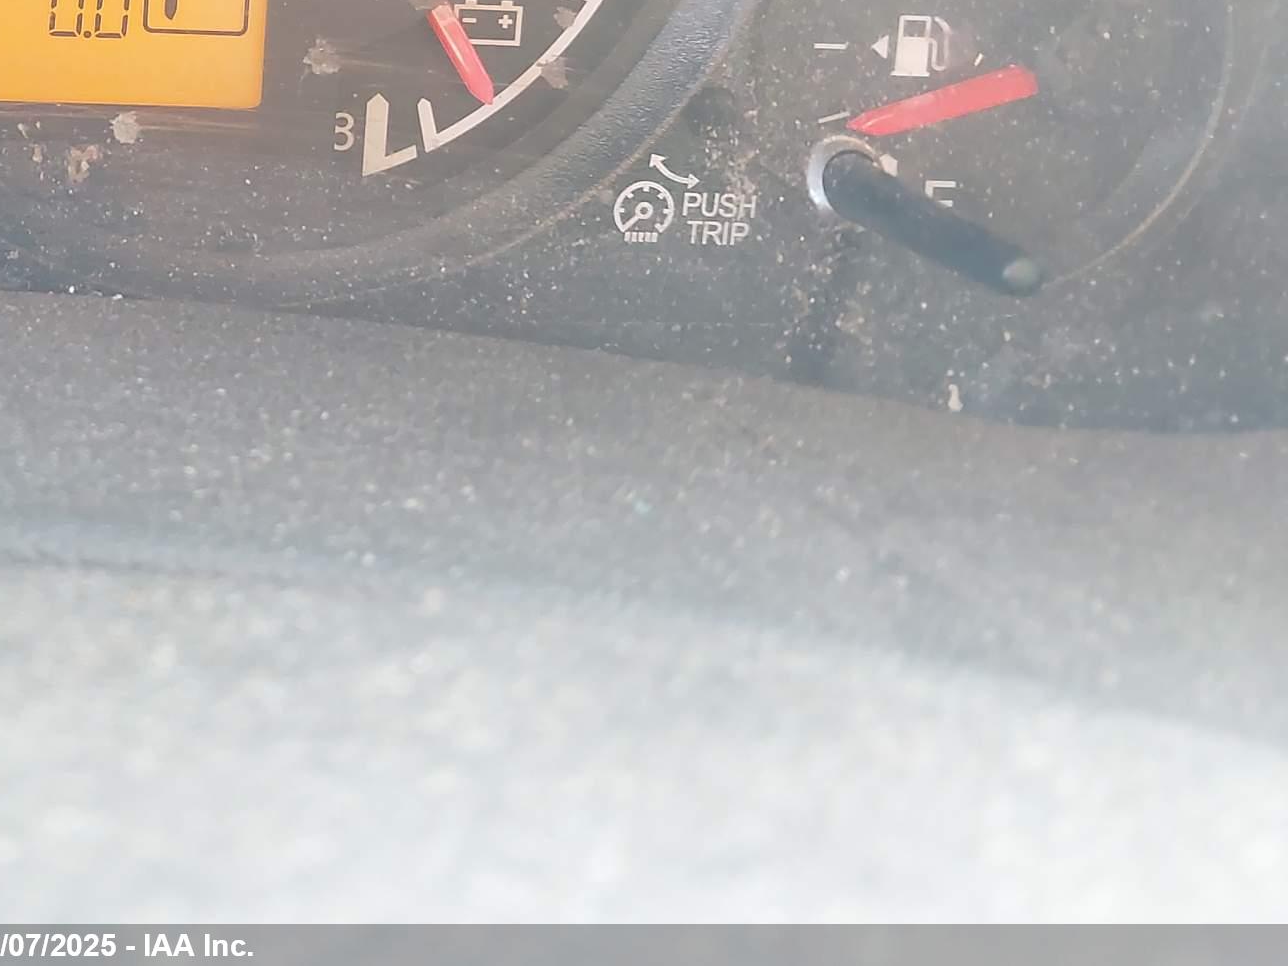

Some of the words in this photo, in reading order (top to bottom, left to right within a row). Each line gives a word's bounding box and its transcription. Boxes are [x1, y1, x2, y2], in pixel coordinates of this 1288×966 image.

[334, 113, 355, 151] 3
[682, 193, 757, 221] PUSH
[686, 221, 751, 246] TRIP
